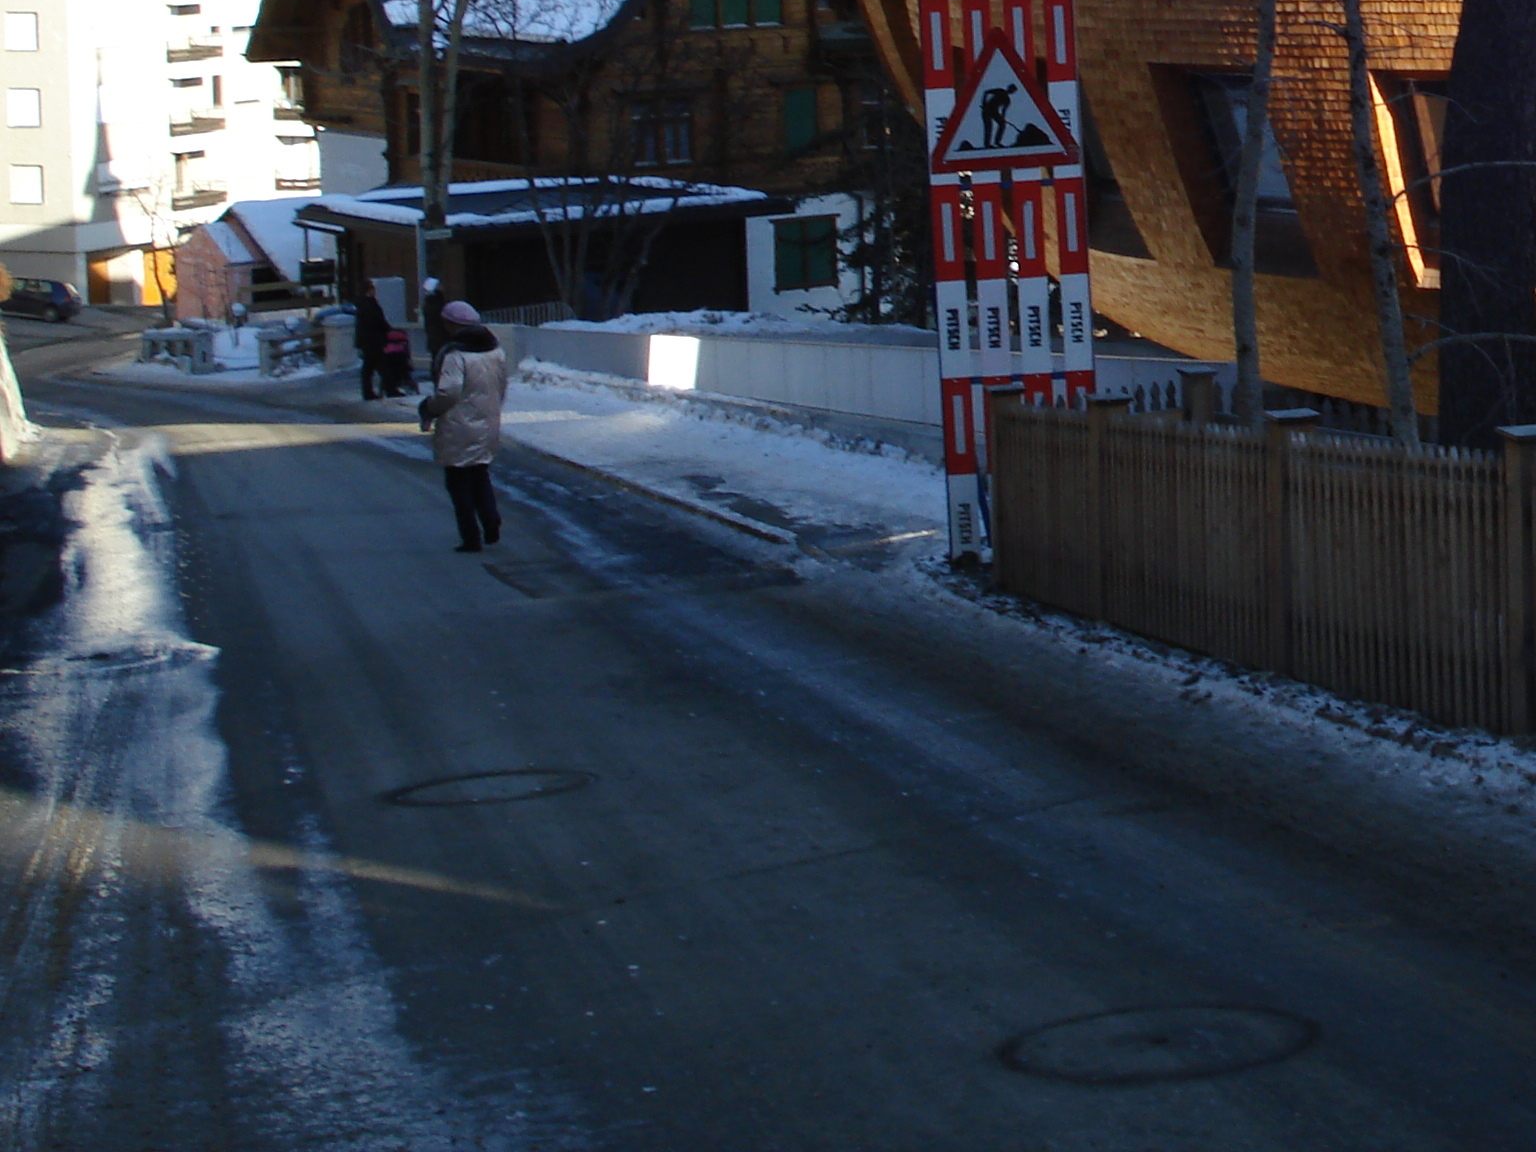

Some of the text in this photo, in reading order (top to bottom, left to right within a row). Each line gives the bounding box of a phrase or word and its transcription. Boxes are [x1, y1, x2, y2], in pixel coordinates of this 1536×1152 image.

[945, 308, 961, 350] PITSCH
[986, 307, 1002, 349] PITSCH
[1027, 305, 1042, 347] PITSCH
[1069, 302, 1084, 343] PITSCH
[957, 503, 973, 544] PITSCH
